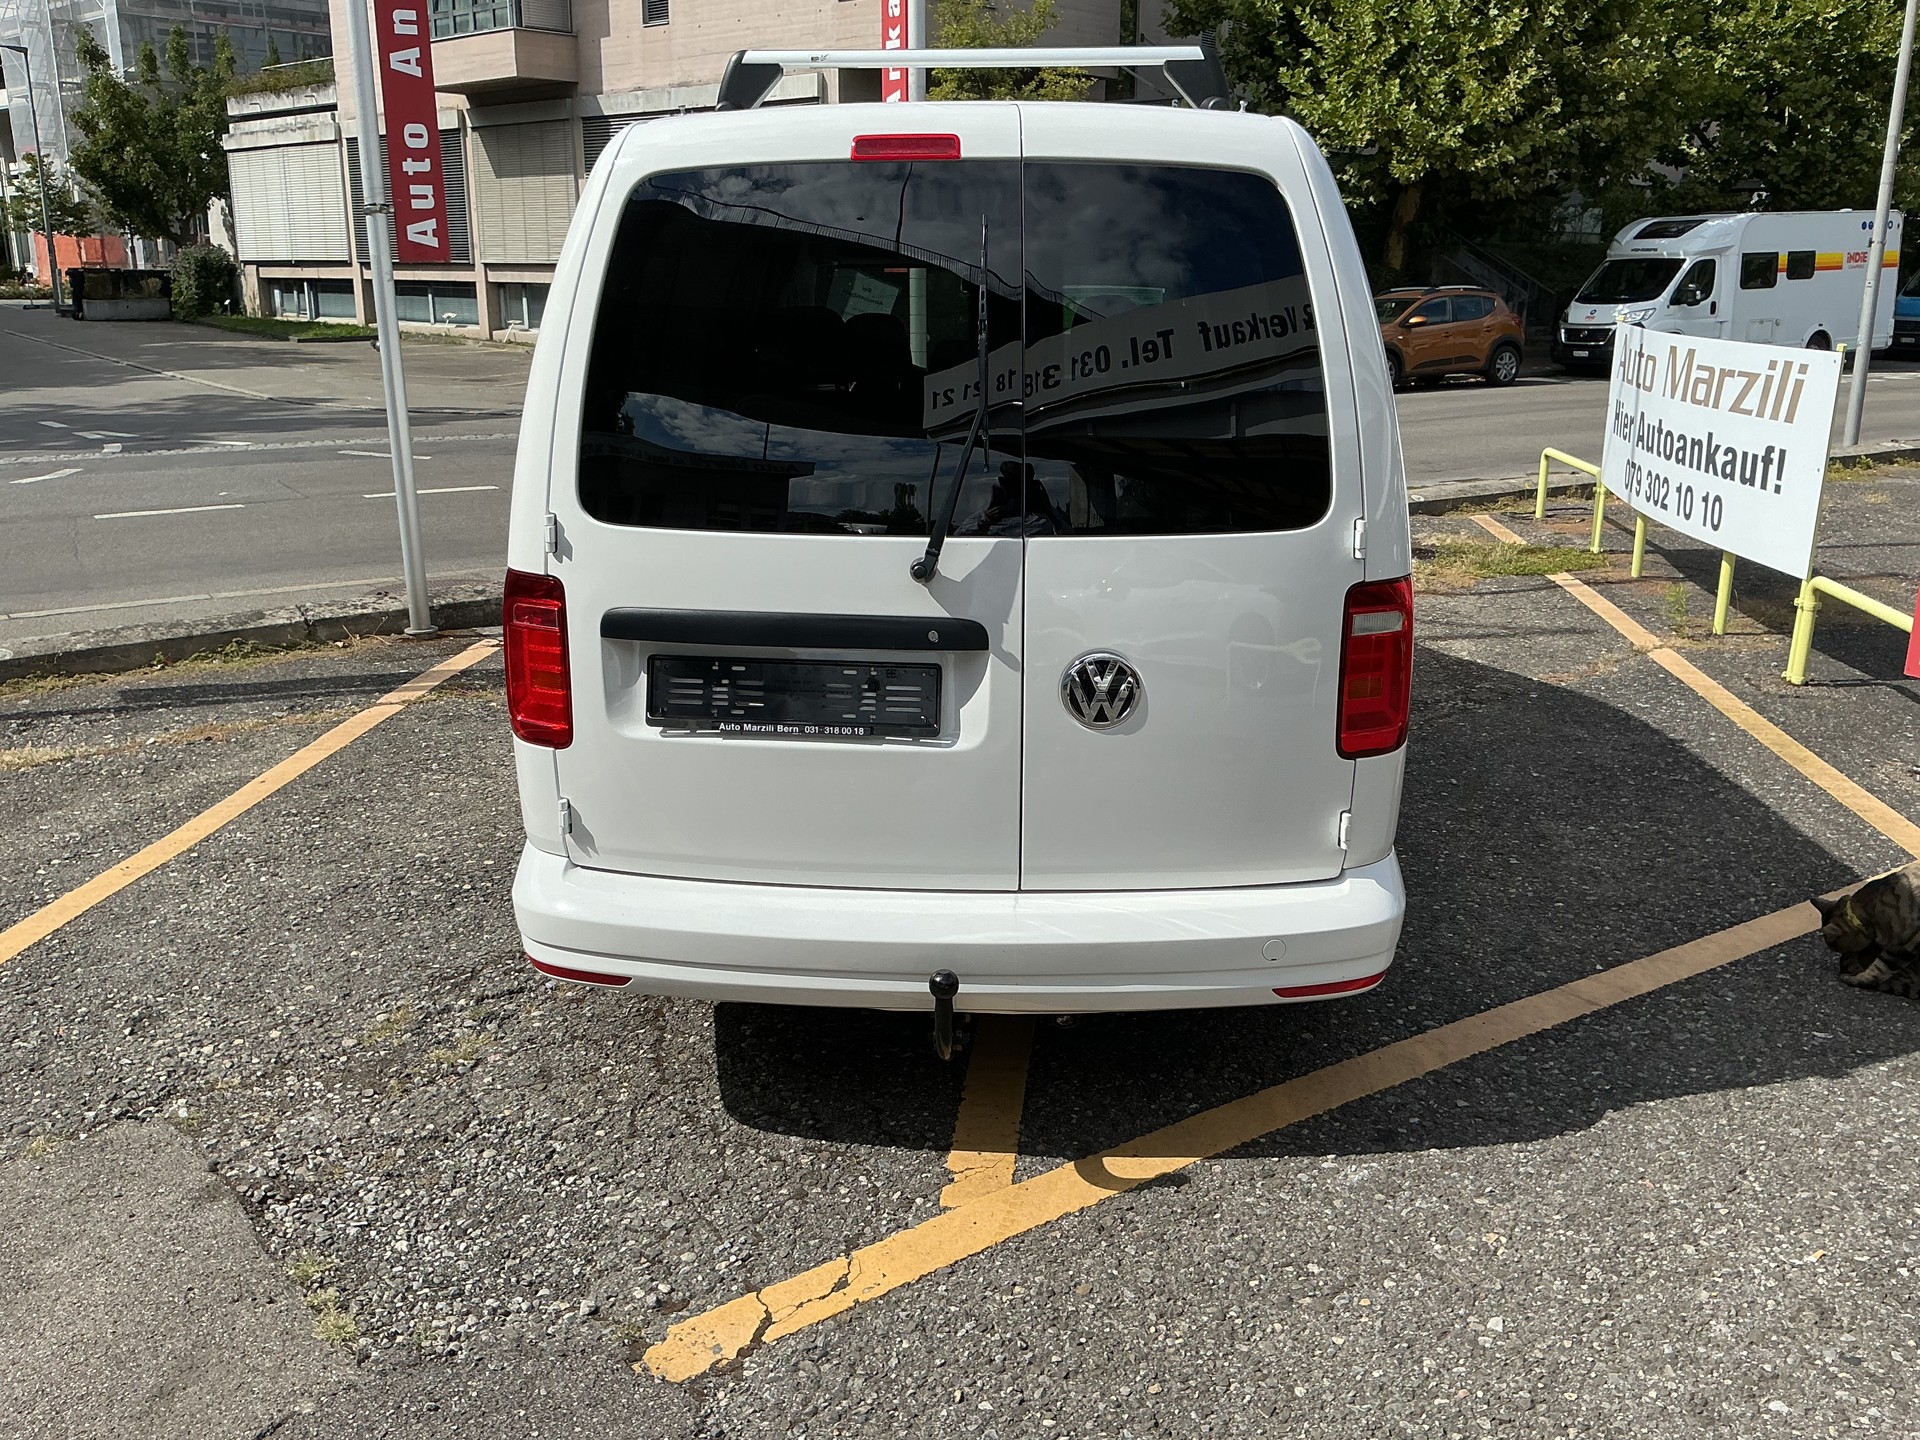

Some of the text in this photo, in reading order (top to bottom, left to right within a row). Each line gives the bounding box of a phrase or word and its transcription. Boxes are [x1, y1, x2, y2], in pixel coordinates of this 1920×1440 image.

[389, 9, 439, 248] Auto An
[1616, 334, 1809, 424] Auto Marzili
[1613, 399, 1787, 495] Hier Autoankauf!
[1624, 458, 1723, 532] 079 302 10 10
[719, 722, 741, 732] Auto
[743, 723, 774, 733] Marzili
[777, 724, 799, 733] Bern
[841, 727, 852, 735] 00
[854, 727, 864, 735] 18
